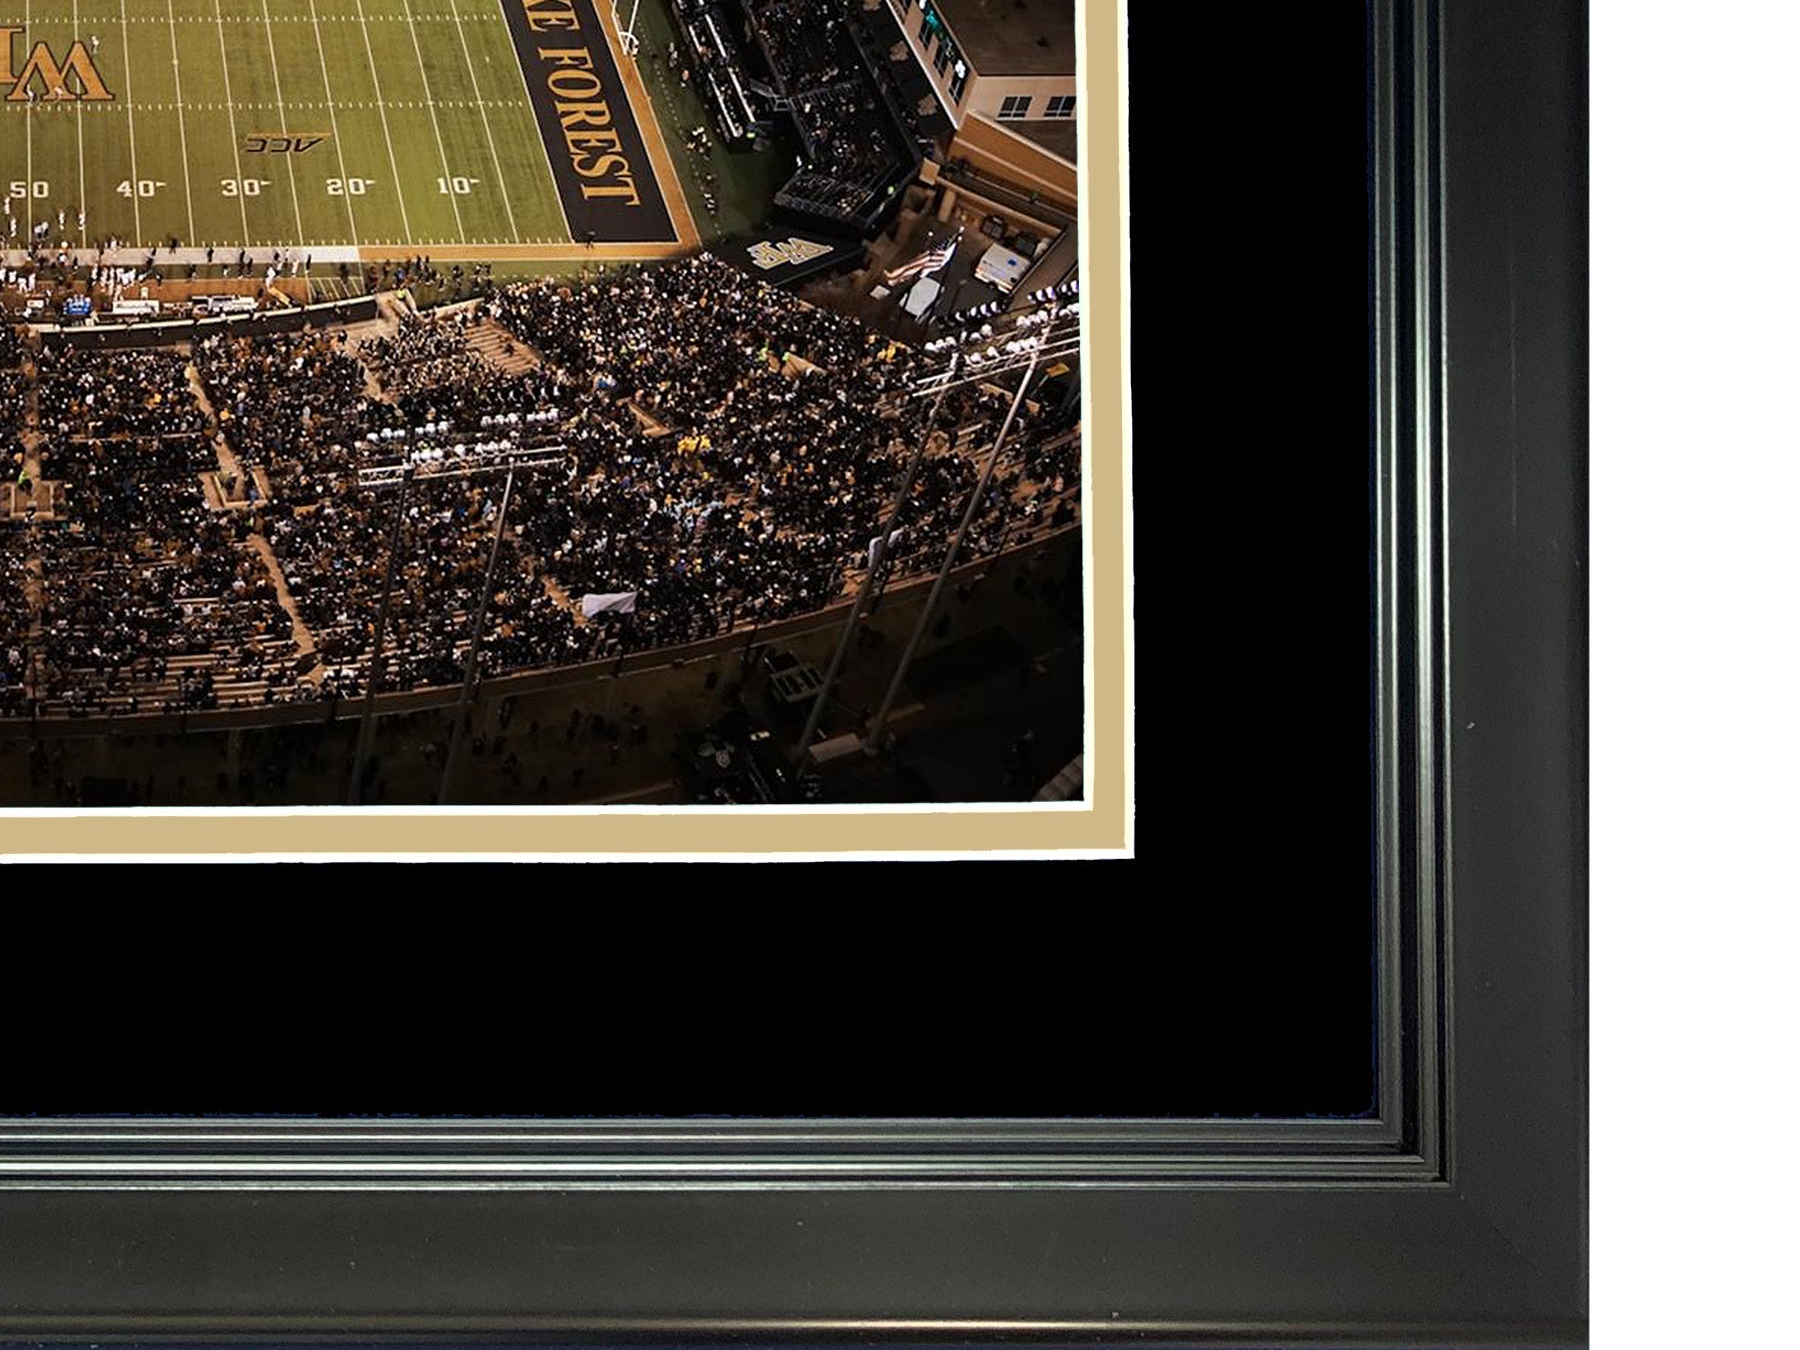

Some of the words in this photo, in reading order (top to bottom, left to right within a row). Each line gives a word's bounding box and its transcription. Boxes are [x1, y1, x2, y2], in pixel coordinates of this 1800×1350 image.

[538, 47, 640, 205] FOREST
[10, 182, 49, 198] 50
[116, 180, 156, 197] 40
[221, 180, 260, 196] 30
[327, 179, 367, 195] 20
[438, 177, 471, 194] 10
